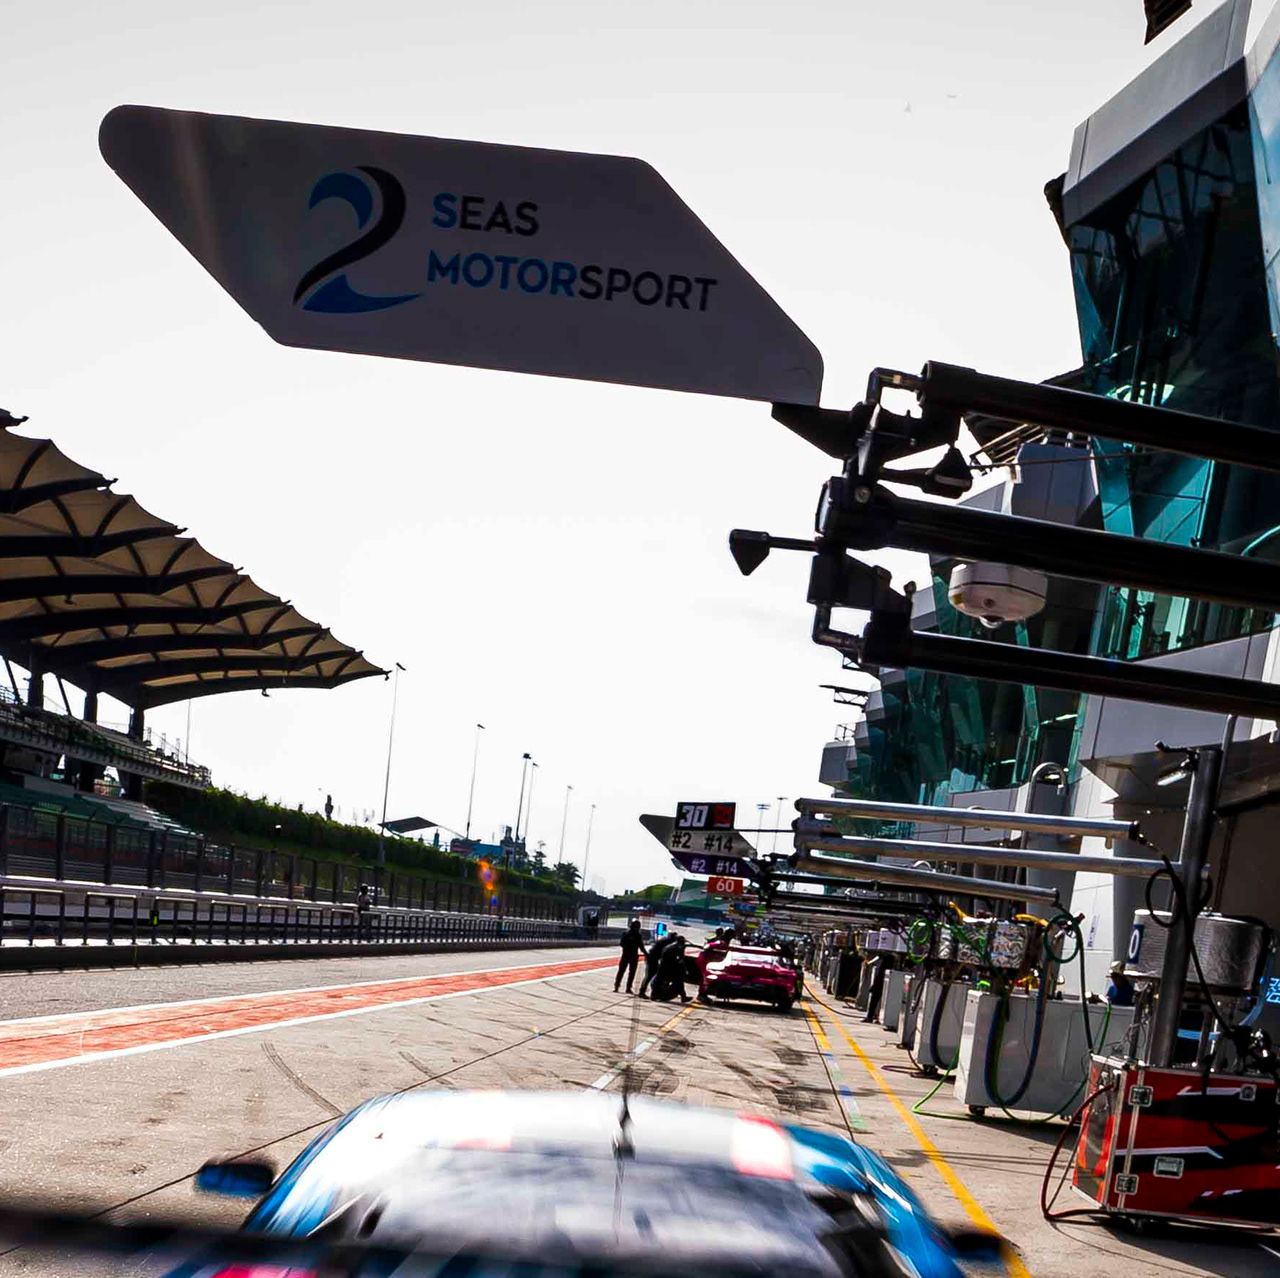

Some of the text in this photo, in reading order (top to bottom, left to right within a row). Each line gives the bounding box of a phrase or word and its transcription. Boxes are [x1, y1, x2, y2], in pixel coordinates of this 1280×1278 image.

[431, 191, 540, 237] SEAS
[426, 249, 718, 312] MOTORSPORT
[679, 805, 708, 827] 30
[671, 831, 733, 852] #2 #14
[690, 859, 738, 875] #2 #14
[716, 879, 735, 893] 60
